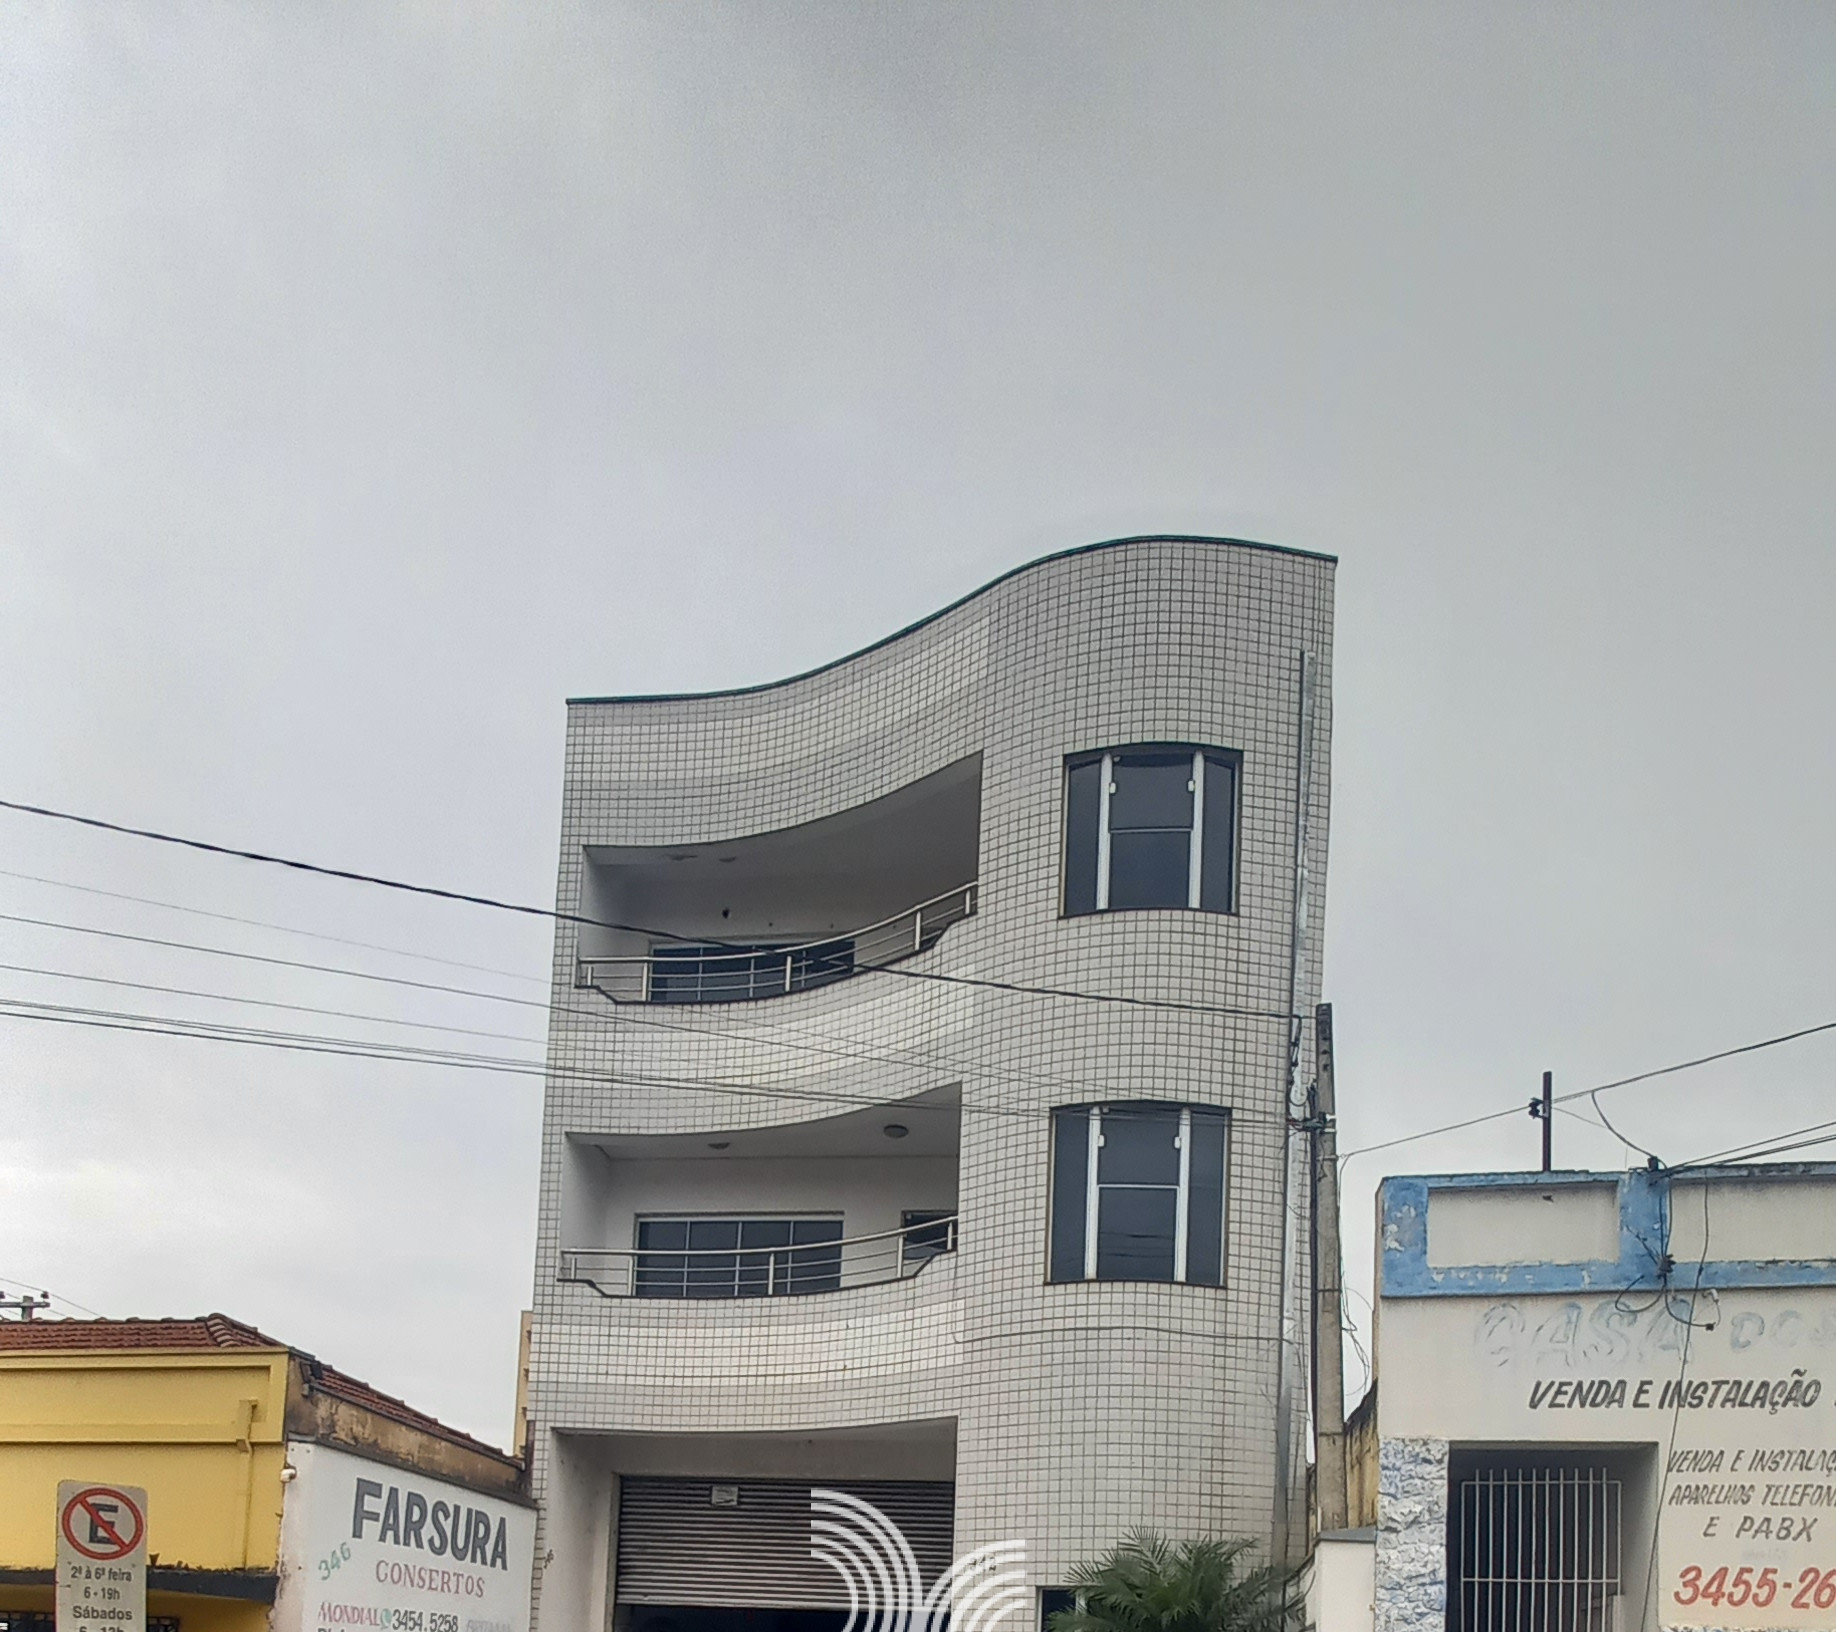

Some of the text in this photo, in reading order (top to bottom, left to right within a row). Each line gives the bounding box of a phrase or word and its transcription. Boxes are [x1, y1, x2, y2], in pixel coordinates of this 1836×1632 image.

[1528, 1369, 1821, 1415] VENDA E INSTALAÇÃO
[1667, 1449, 1725, 1473] VENDA
[1730, 1449, 1745, 1472] E
[1668, 1484, 1836, 1507] APARELHOS TELEFON
[352, 1477, 508, 1571] FARSURA
[1702, 1515, 1818, 1543] E PABX
[85, 1566, 92, 1580] à
[108, 1567, 132, 1582] feira
[318, 1541, 352, 1581] 346
[375, 1559, 485, 1598] CONSERTOS
[1673, 1565, 1836, 1609] 3455-26
[100, 1587, 120, 1601] 19h
[72, 1605, 133, 1621] Sábados
[318, 1602, 380, 1626] MONDIAL
